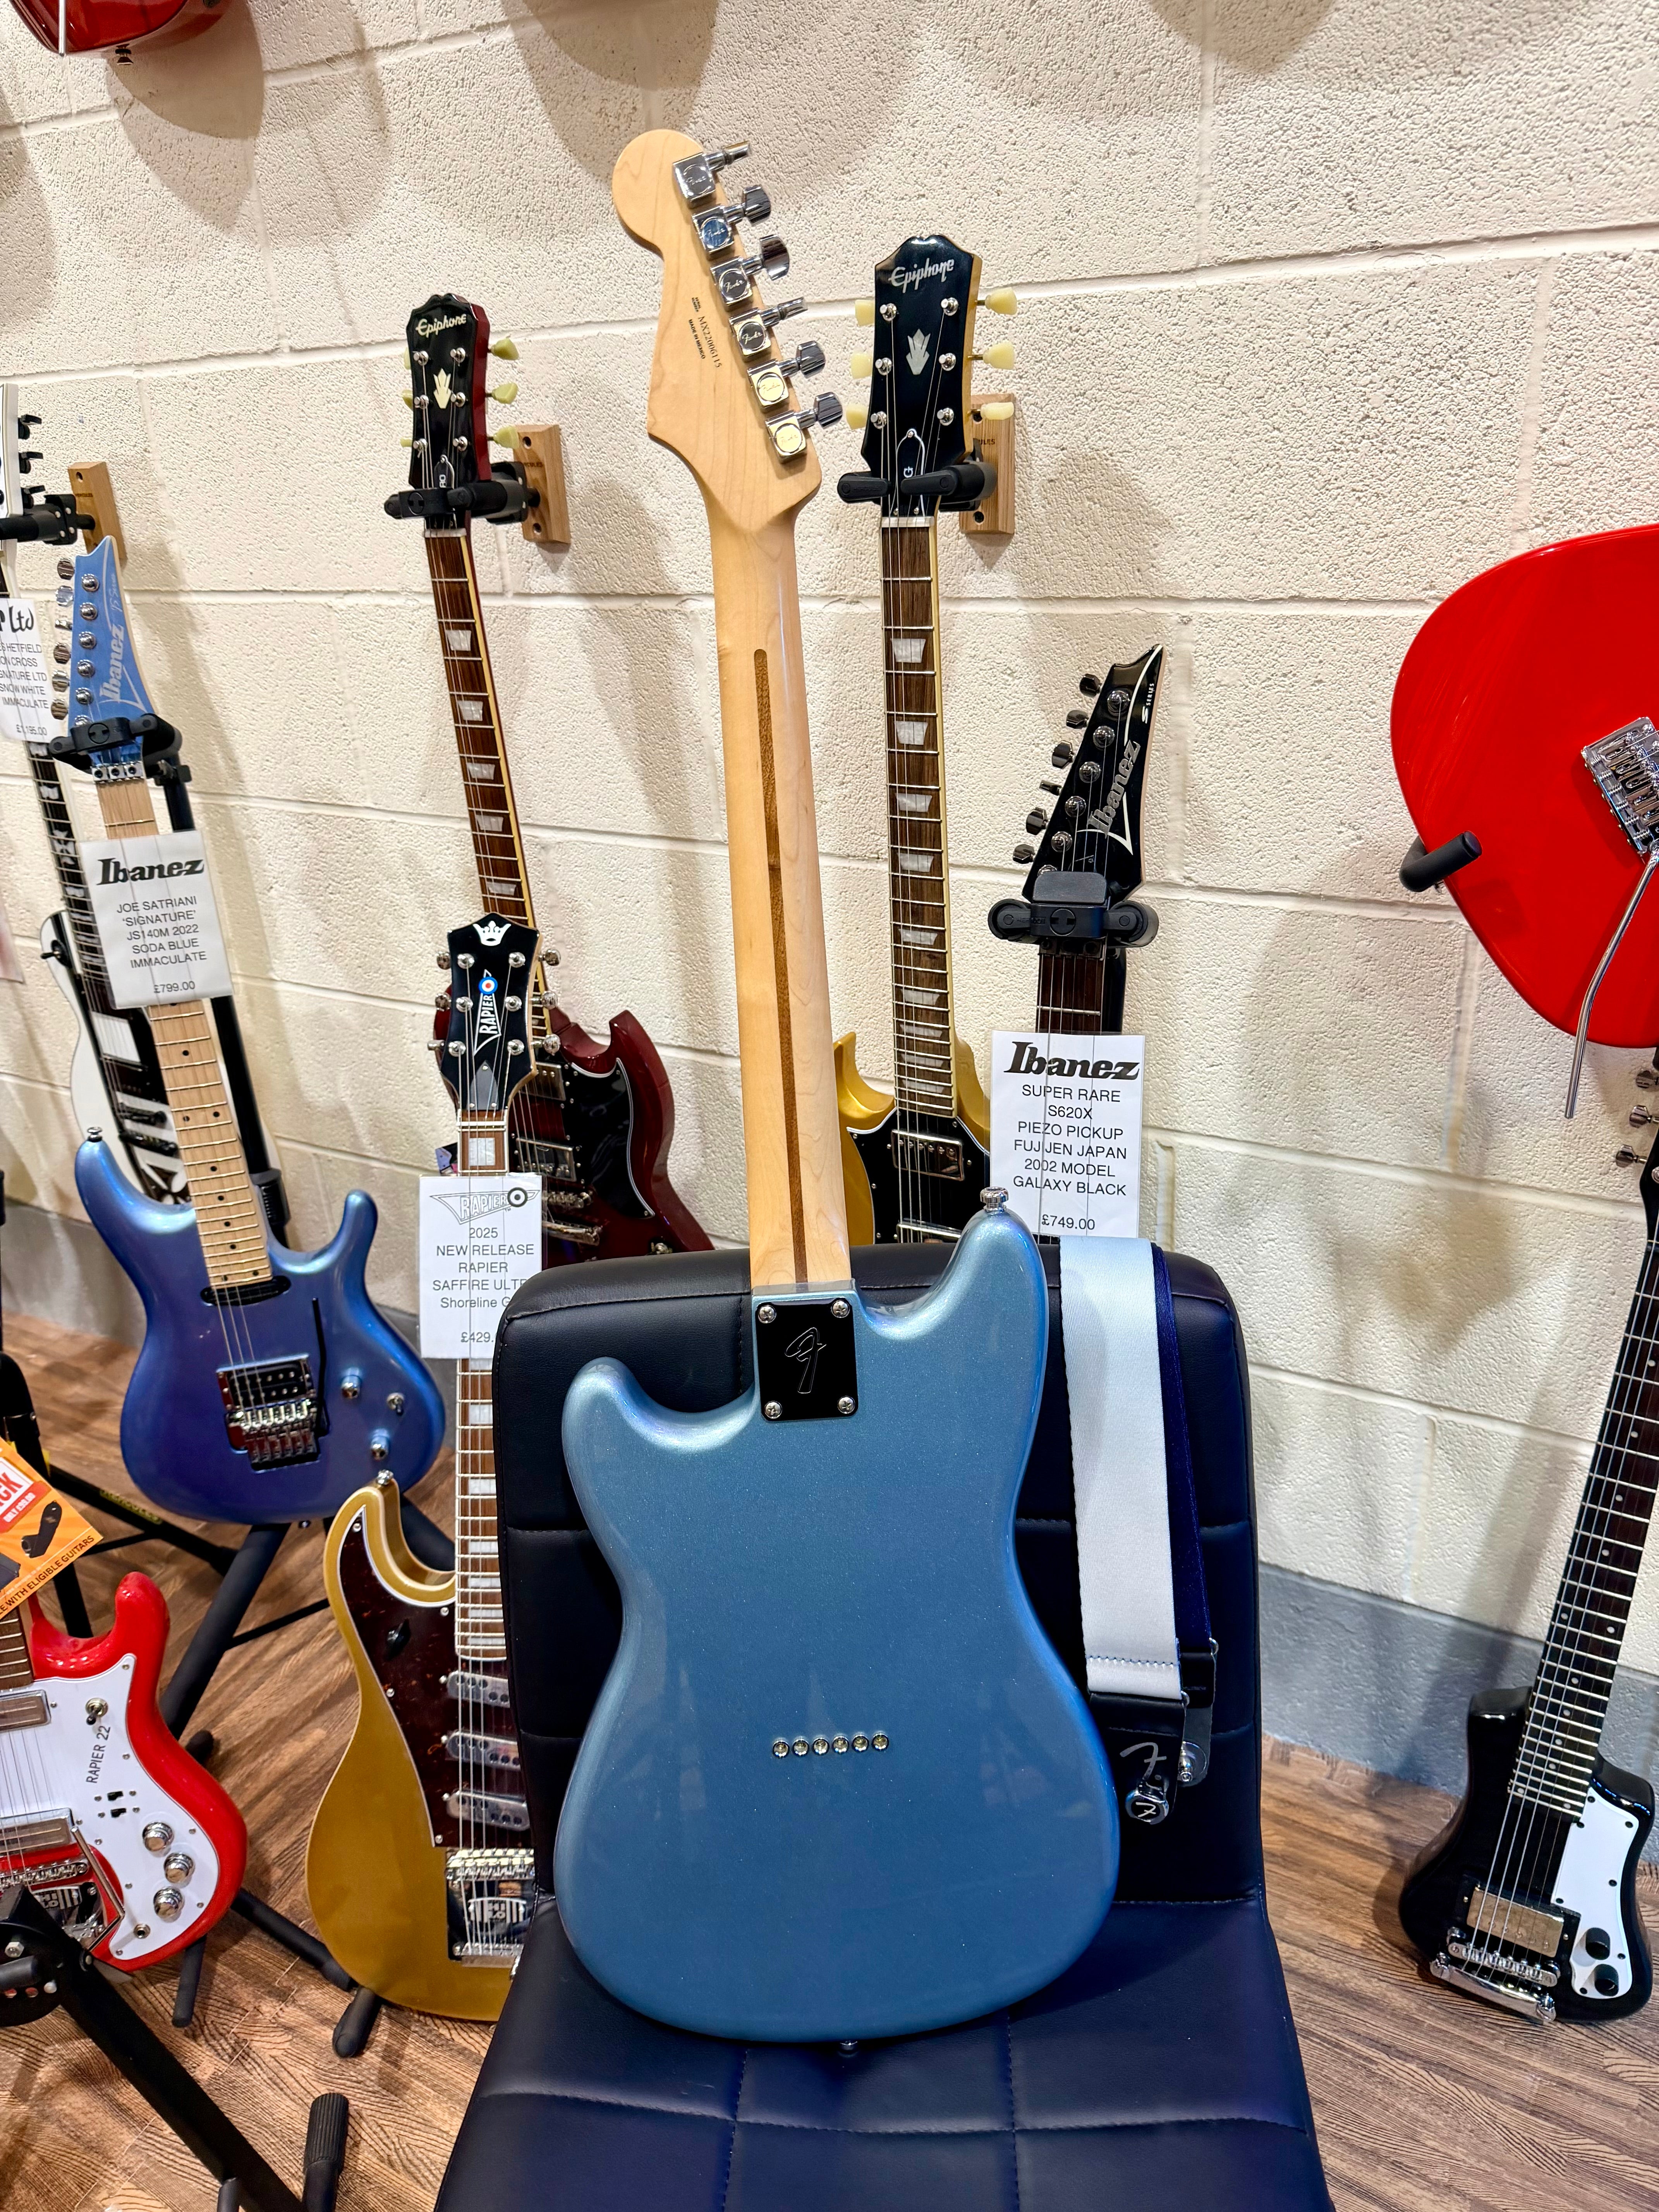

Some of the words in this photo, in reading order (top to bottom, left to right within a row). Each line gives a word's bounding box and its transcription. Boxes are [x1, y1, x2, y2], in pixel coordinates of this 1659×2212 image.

[888, 258, 955, 293] Epiphone
[415, 313, 467, 338] Epiphone
[696, 340, 706, 359] MEXICO
[6, 643, 42, 653] HETFIELD
[11, 657, 38, 667] CROSS
[99, 624, 124, 702] Ibanez
[33, 672, 47, 682] LTD
[20, 685, 46, 695] WHITE
[1146, 683, 1154, 706] SERIES
[2, 697, 49, 709] IMMACULATE
[1087, 739, 1141, 839] Ibanez
[96, 858, 204, 885] Ibanez
[117, 902, 140, 913] JOE
[143, 896, 197, 911] SATRIANI
[127, 928, 169, 941] JS140M
[173, 924, 199, 936] 2022
[132, 943, 166, 954] SODA
[169, 938, 199, 950] BLUE
[130, 951, 207, 968] IMMACULATE
[154, 981, 196, 993] £799.00
[479, 995, 499, 1034] RAPIER
[1003, 1041, 1140, 1080] Ibanez
[1022, 1084, 1073, 1100] SUPER
[1078, 1089, 1121, 1103] RARE
[1048, 1105, 1093, 1120] S620X
[1018, 1121, 1062, 1136] PIEZO
[1067, 1125, 1124, 1140] PICKUP
[1077, 1145, 1127, 1159] JAPAN
[1024, 1158, 1057, 1172] 2002
[1061, 1162, 1116, 1177] MODEL
[1013, 1176, 1072, 1192] GALAXY
[1077, 1181, 1127, 1196] BLACK
[460, 1193, 508, 1219] RAPIER
[1041, 1214, 1095, 1230] £749.00
[469, 1227, 498, 1238] 2025
[436, 1245, 468, 1256] NEW
[472, 1244, 534, 1255] RELEASE
[459, 1262, 508, 1273] RAPIER
[433, 1279, 489, 1291] SAFFIRE
[440, 1296, 497, 1308] Shoreline
[5, 1588, 28, 1606] WITH
[27, 1560, 63, 1590] ELIGIBLE
[61, 1535, 95, 1562] GUITARS
[86, 1744, 106, 1783] RAPIER
[96, 1726, 111, 1741] 22
